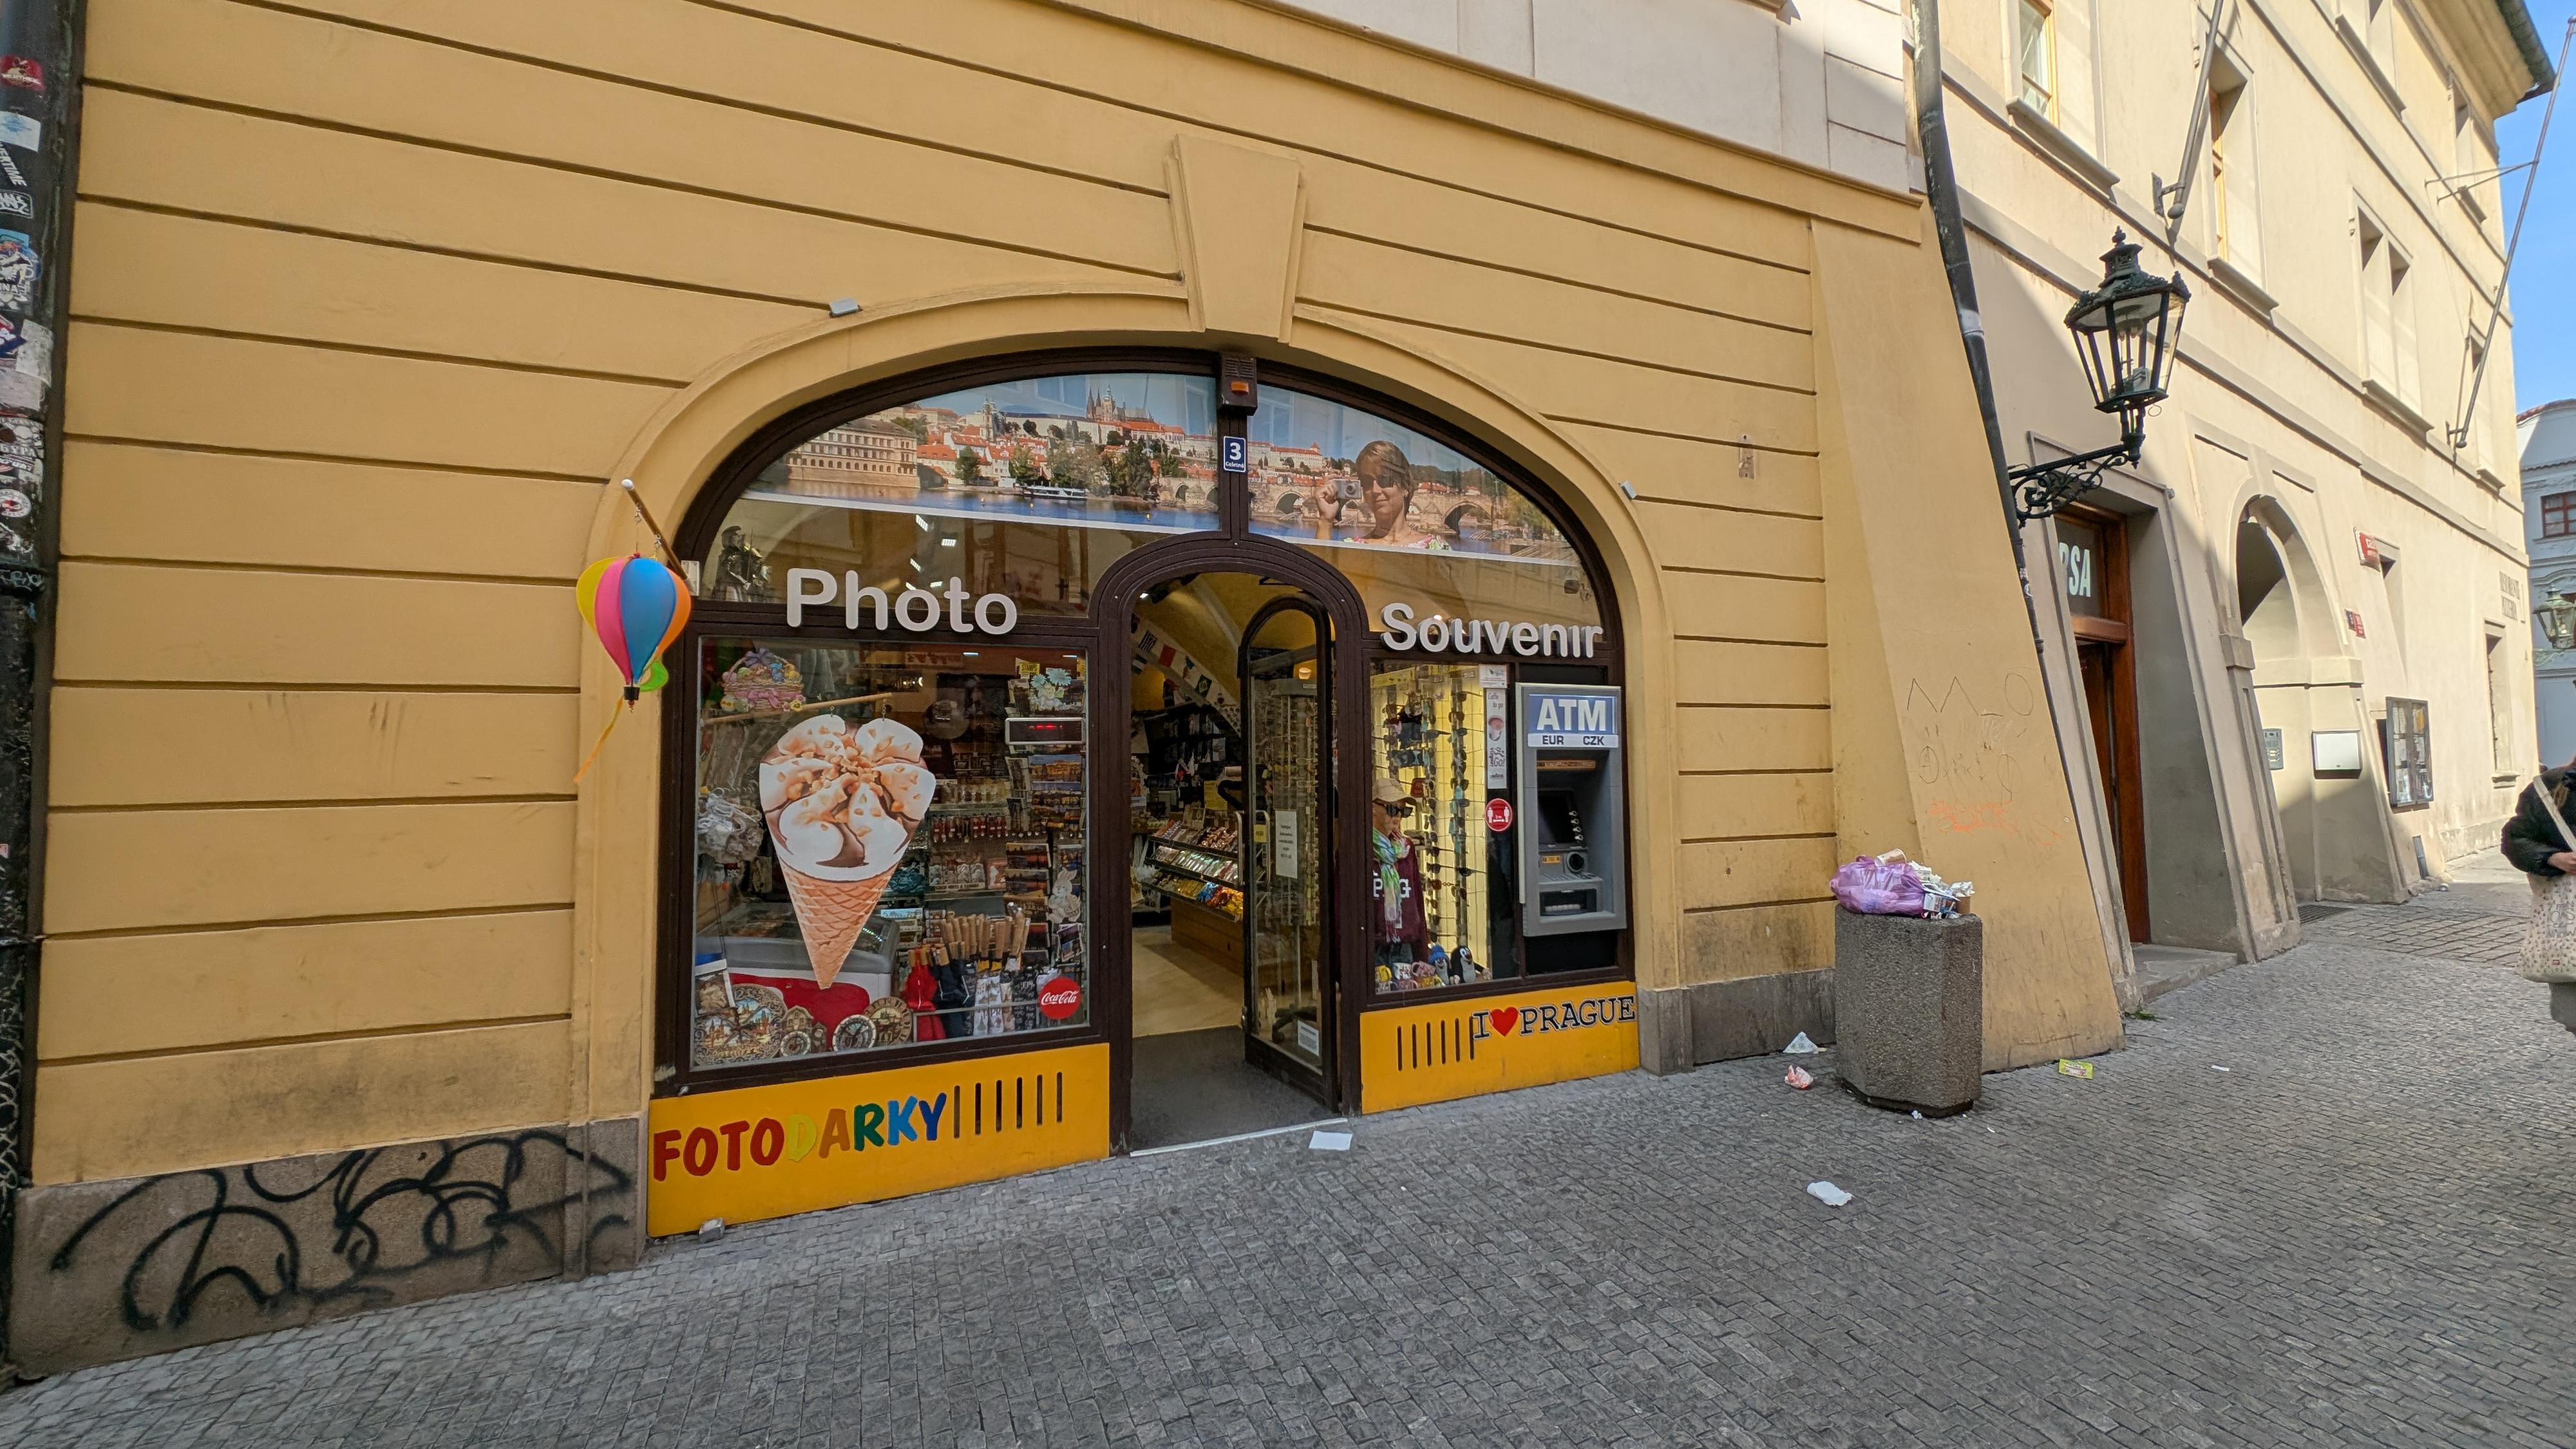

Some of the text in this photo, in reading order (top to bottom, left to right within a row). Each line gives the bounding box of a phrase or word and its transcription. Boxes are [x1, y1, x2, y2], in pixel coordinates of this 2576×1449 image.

[0, 141, 27, 186] ERTIME
[1230, 442, 1242, 460] 3
[786, 568, 1018, 636] Photo
[1381, 603, 1603, 658] Souvenir
[1537, 698, 1606, 732] ATM
[1542, 735, 1605, 746] EUR CZK
[1041, 990, 1081, 1006] Coca-Cola
[1473, 996, 1636, 1039] I PRAGUE
